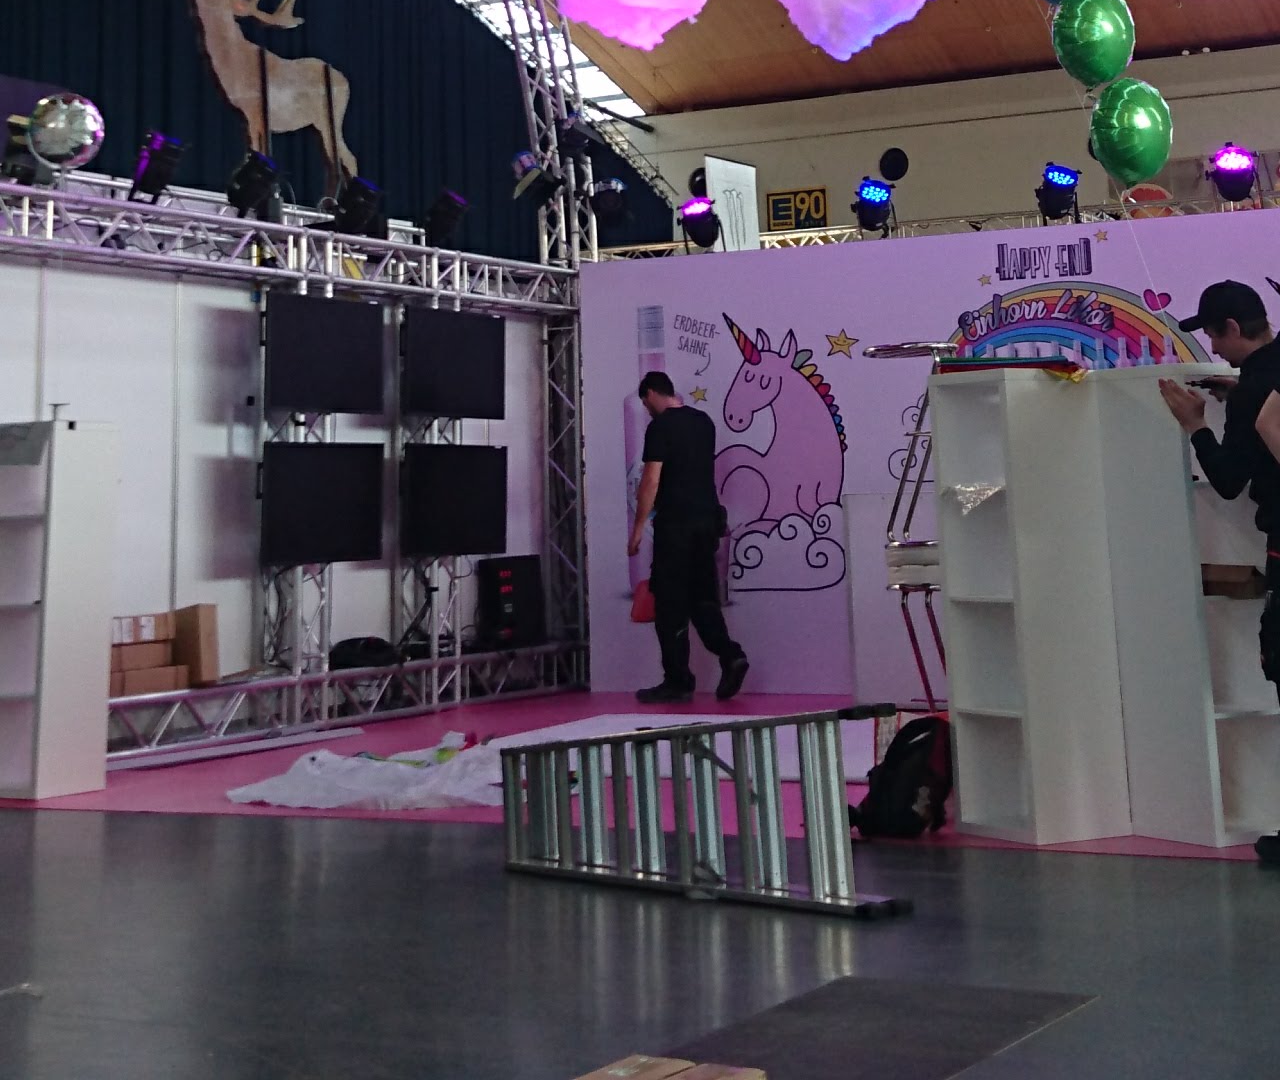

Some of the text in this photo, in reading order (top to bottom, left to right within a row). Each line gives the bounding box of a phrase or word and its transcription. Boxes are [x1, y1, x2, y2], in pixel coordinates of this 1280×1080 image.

[996, 237, 1093, 281] HAPPY END
[673, 314, 721, 339] ERDBEER-
[958, 293, 1048, 341] Einhorn
[677, 335, 710, 358] SAHNE
